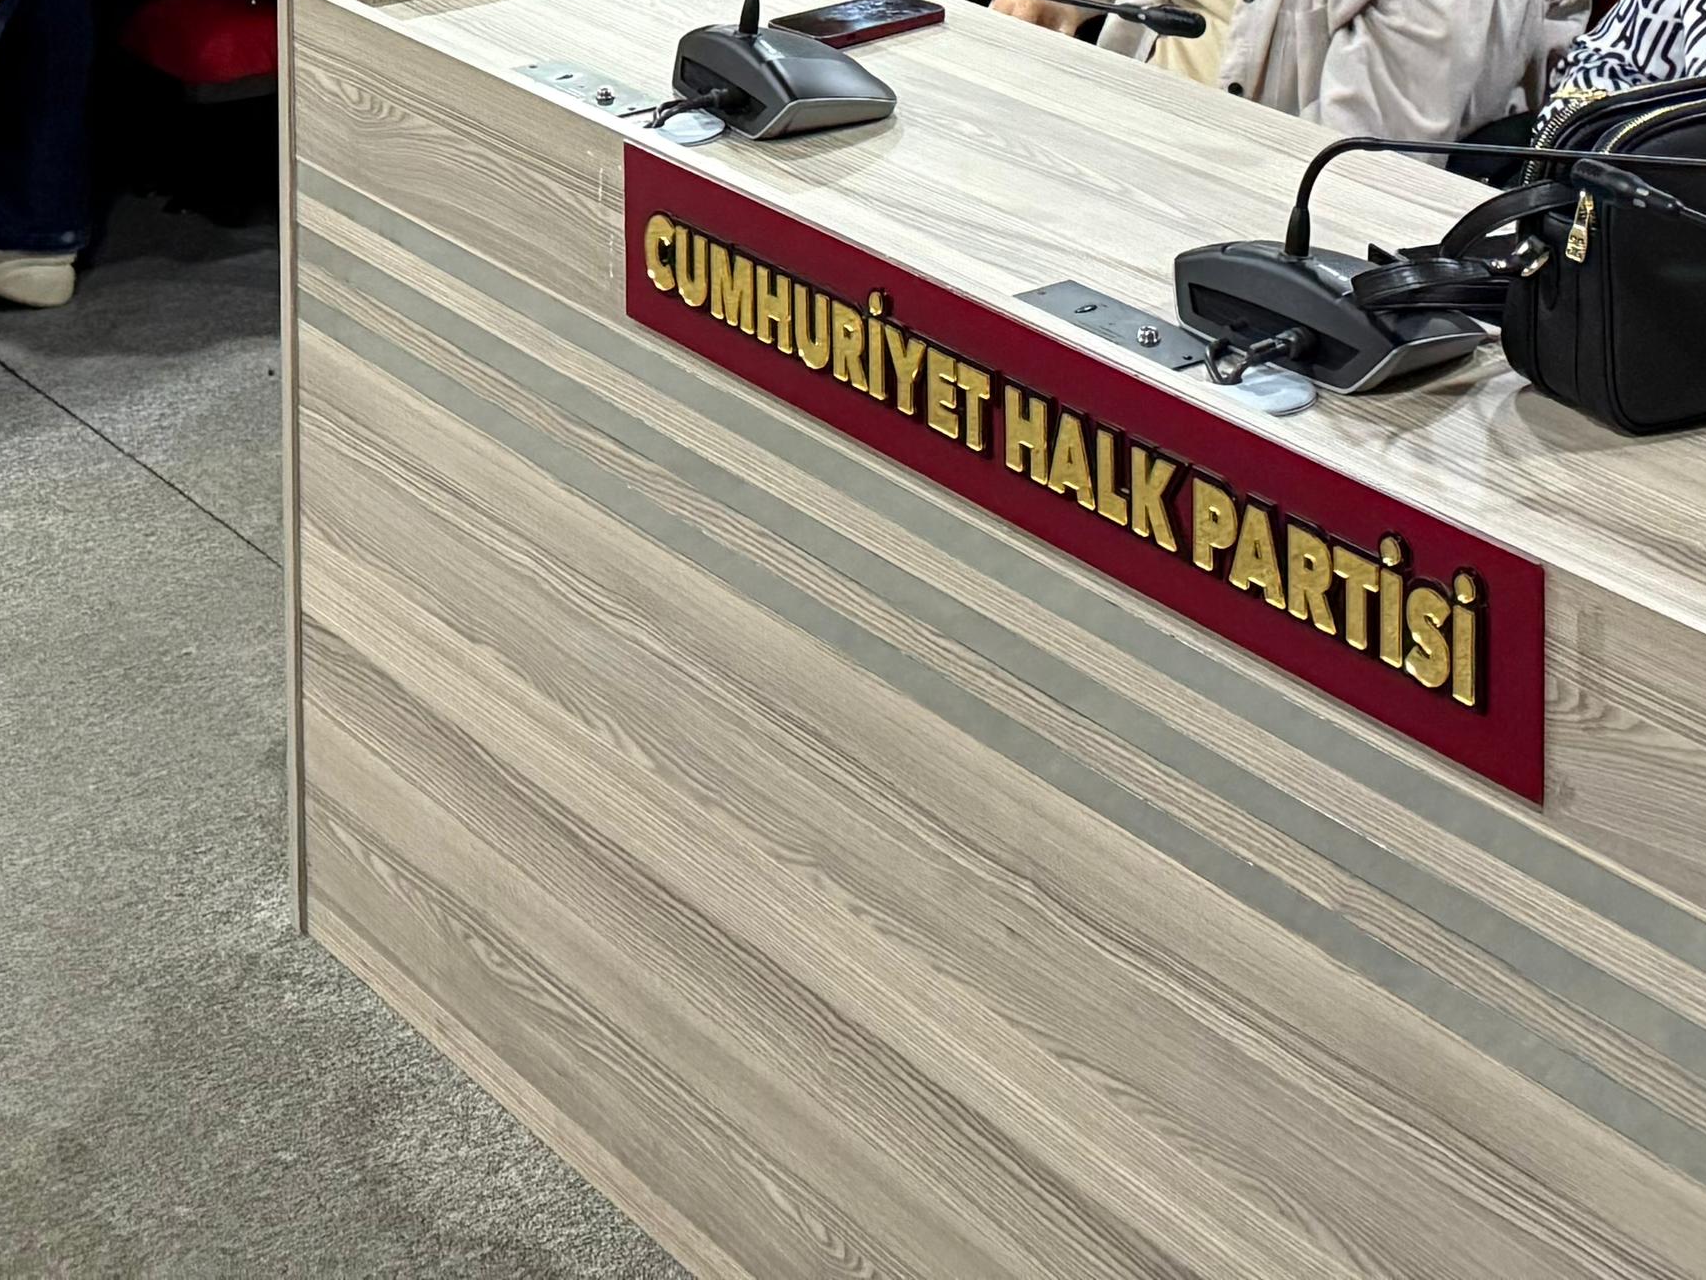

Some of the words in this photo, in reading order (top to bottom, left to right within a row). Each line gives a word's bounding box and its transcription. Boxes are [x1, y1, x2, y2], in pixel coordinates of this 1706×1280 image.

[644, 213, 992, 452] CUMHURİYET
[1004, 383, 1179, 553] HALK
[1192, 476, 1478, 708] PARTİSİ
